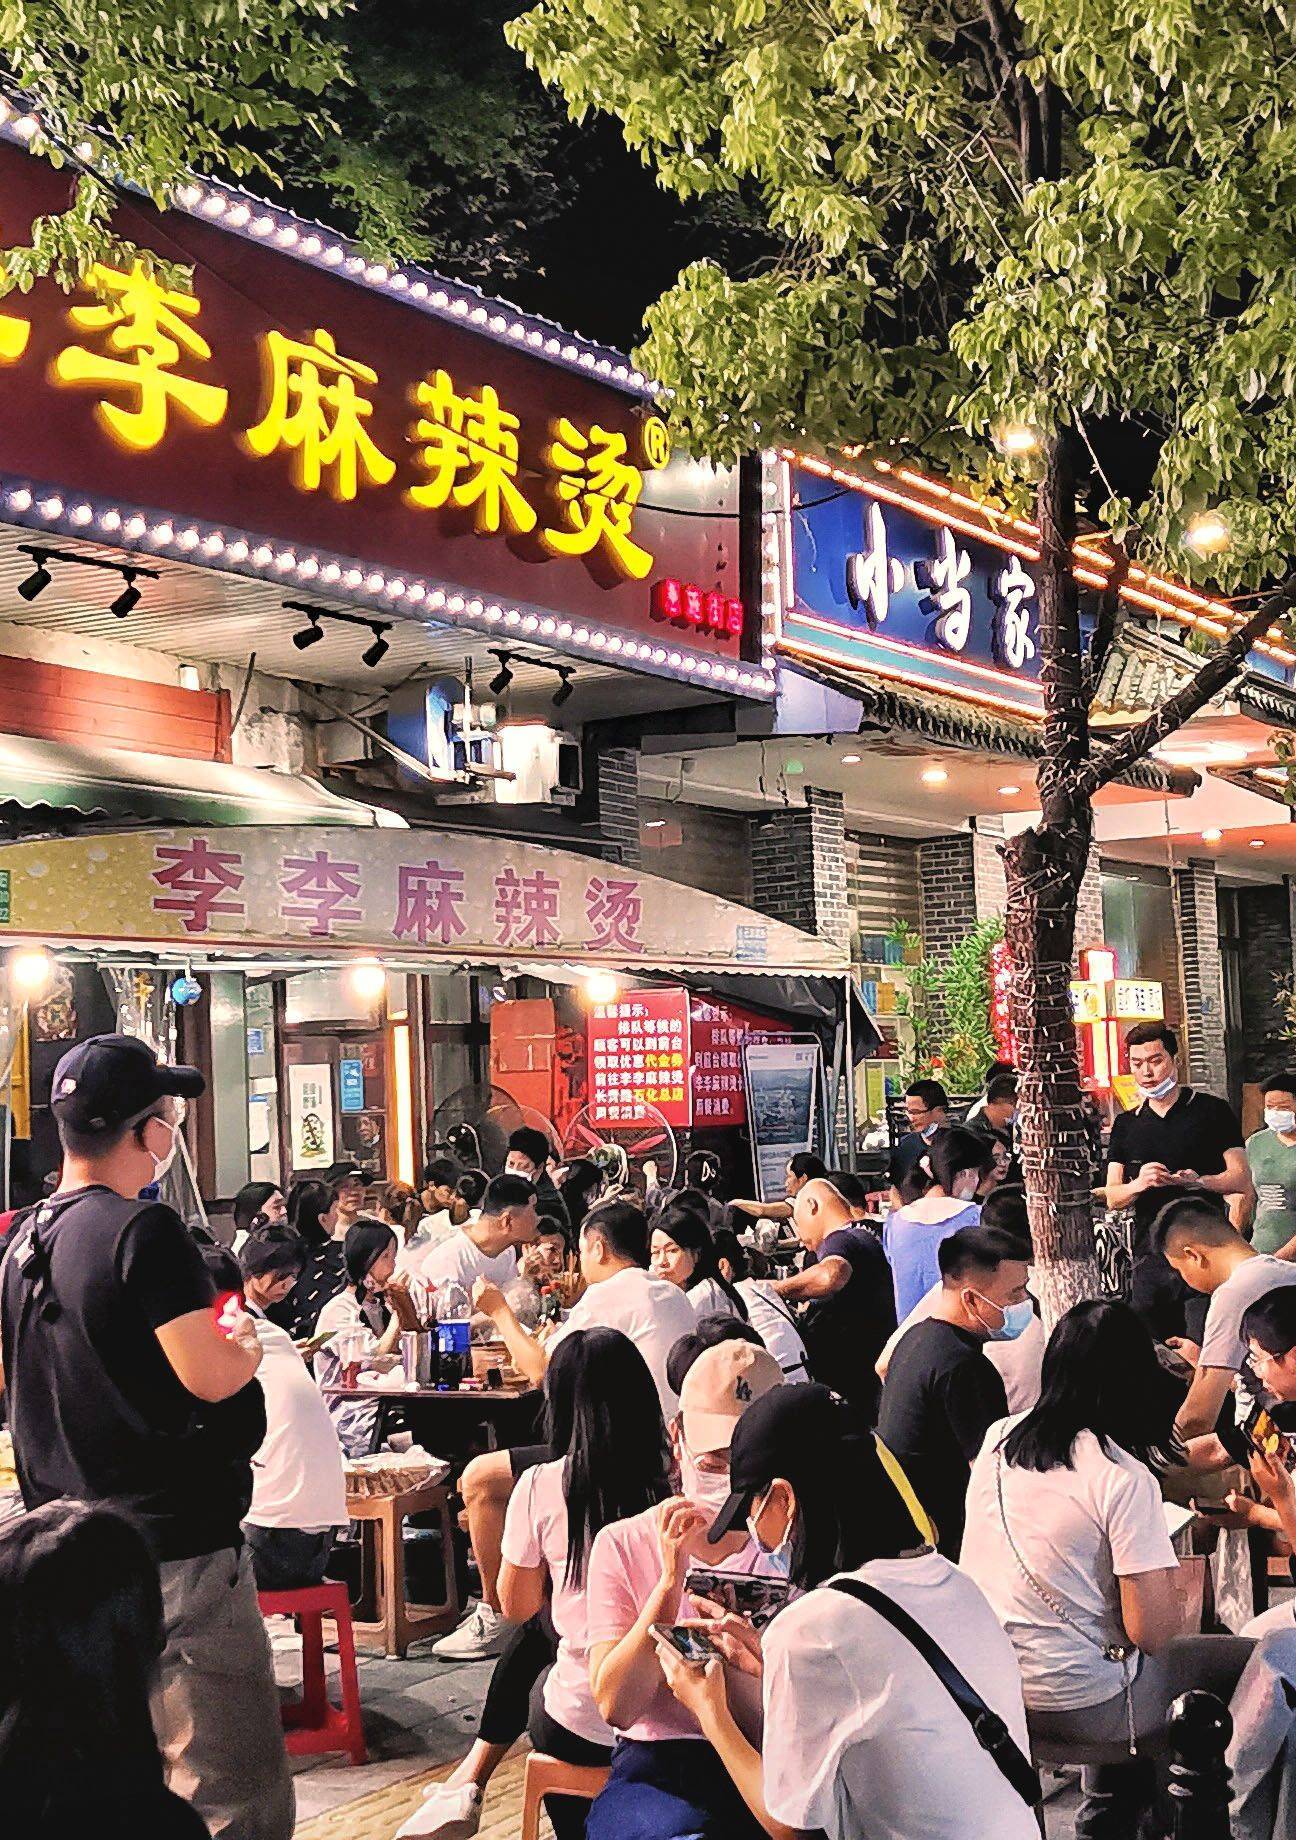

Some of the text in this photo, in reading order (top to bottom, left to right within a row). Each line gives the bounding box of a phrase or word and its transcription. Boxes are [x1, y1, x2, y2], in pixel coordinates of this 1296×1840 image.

[852, 501, 1037, 669] 小当家
[152, 837, 646, 955] 李李麻辣烫
